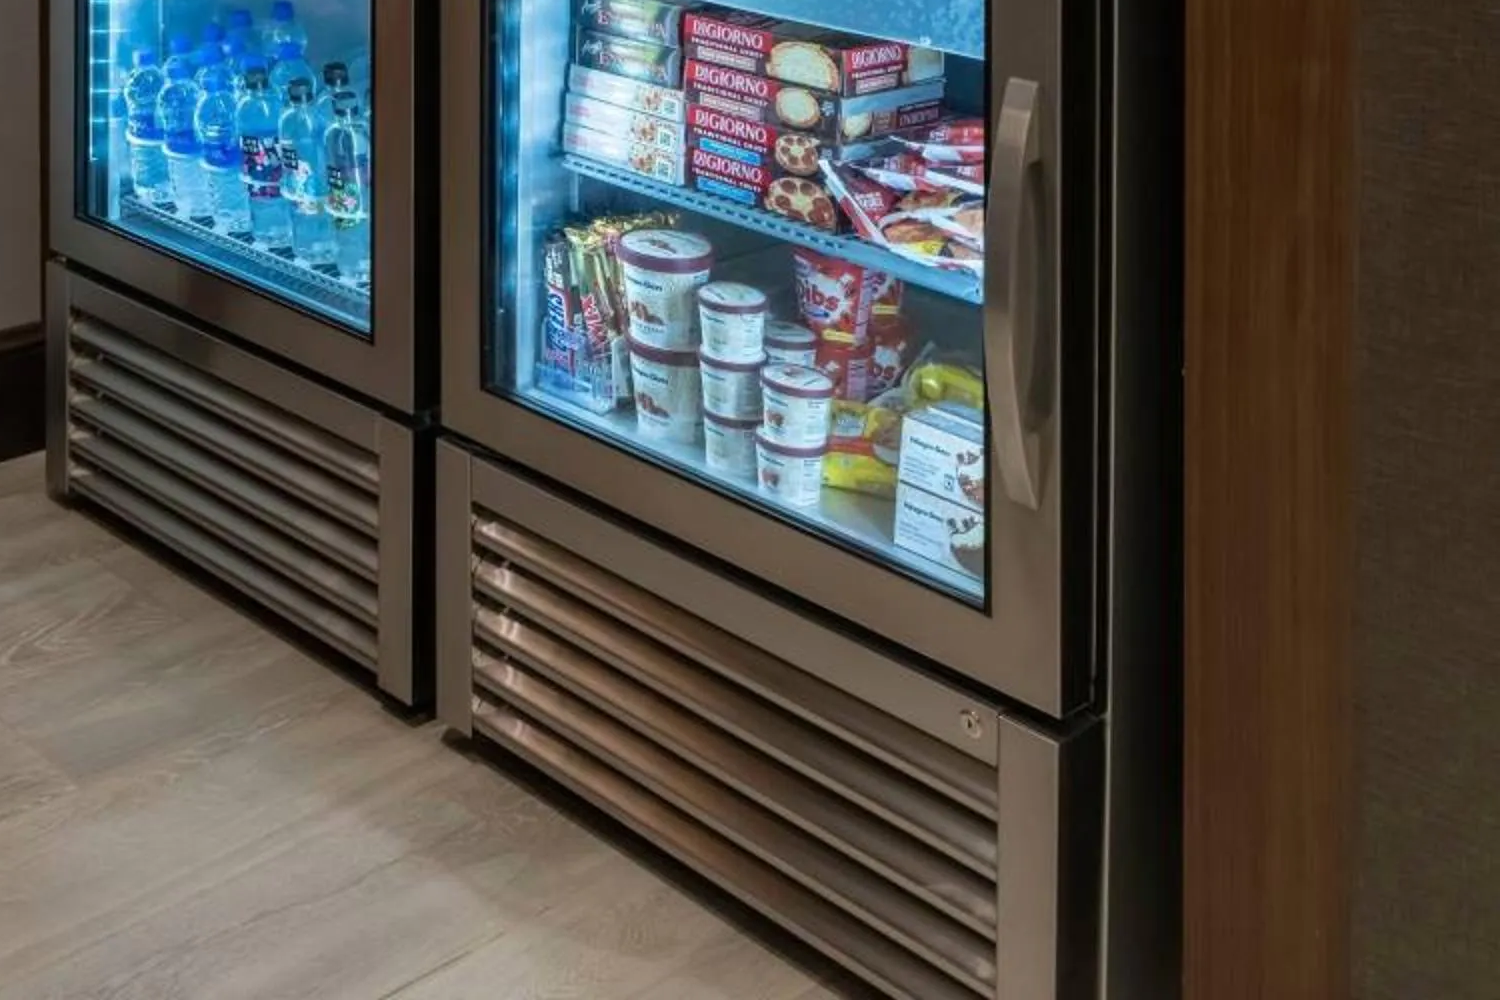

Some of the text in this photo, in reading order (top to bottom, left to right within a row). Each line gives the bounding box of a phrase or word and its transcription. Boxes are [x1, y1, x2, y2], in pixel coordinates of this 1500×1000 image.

[692, 20, 764, 48] DIGIORNO
[694, 65, 768, 97] DIGIORNO
[694, 109, 768, 143] DIGIORNO
[692, 151, 763, 183] DIGIORNO
